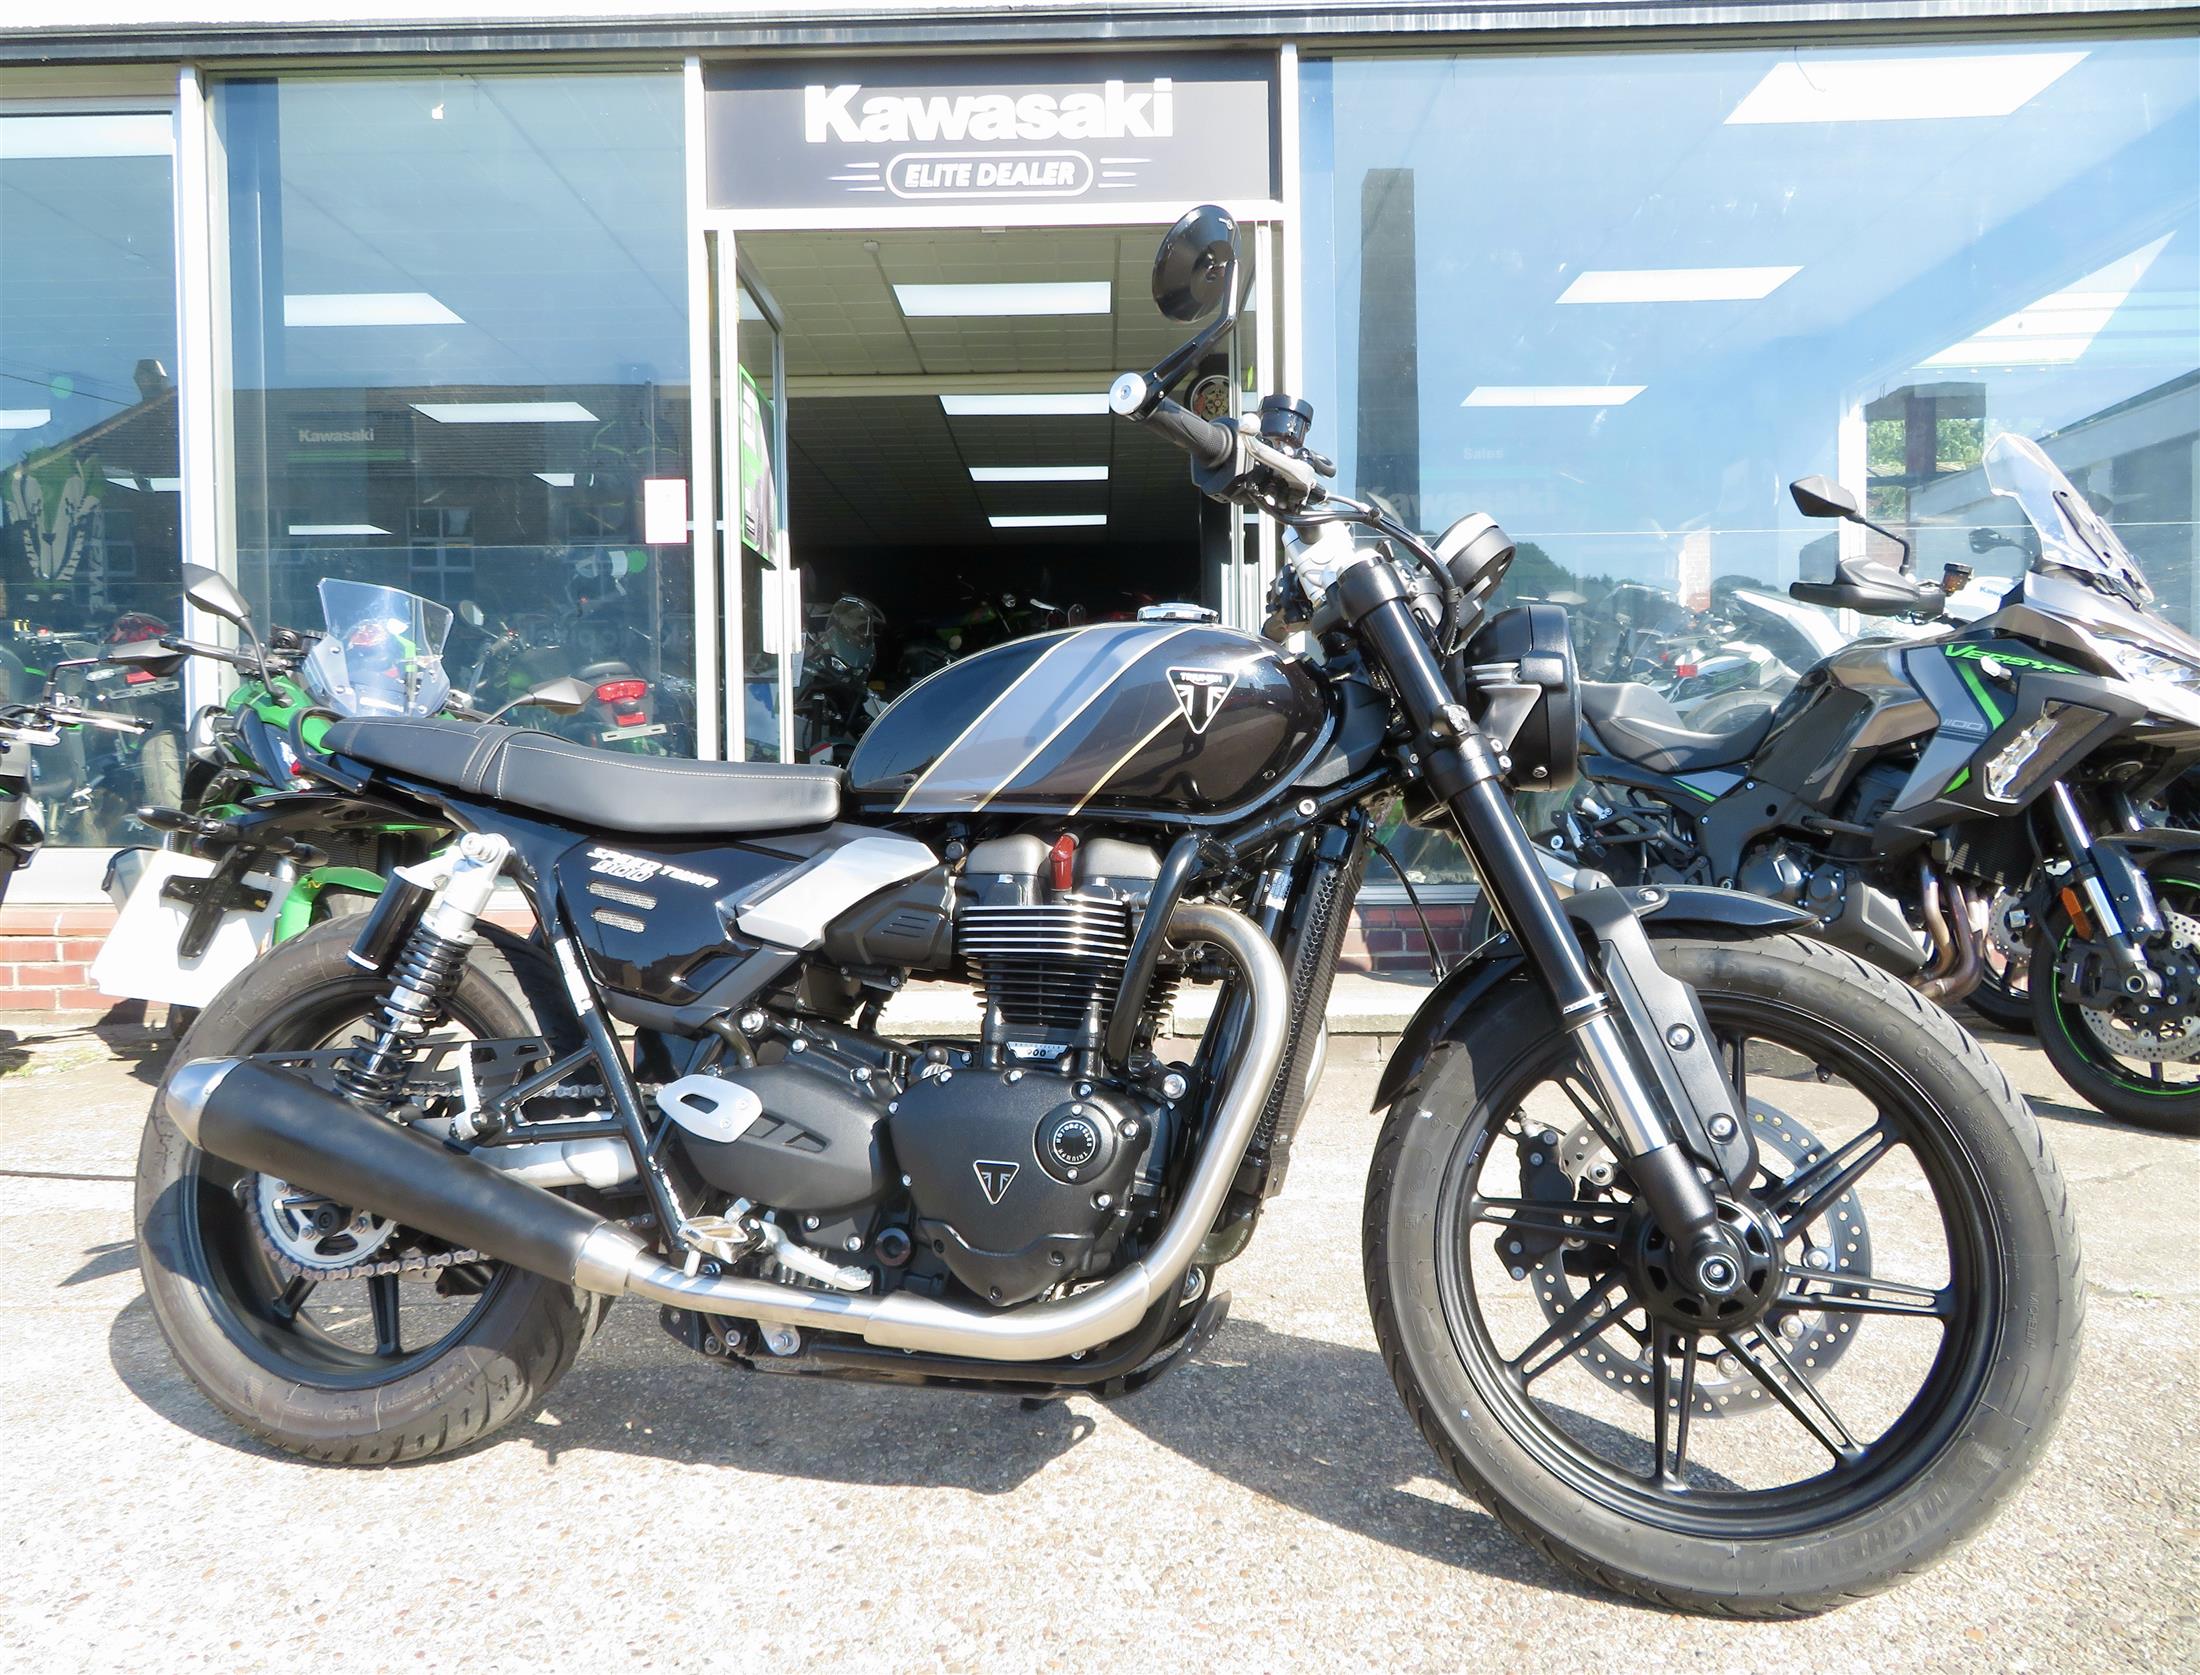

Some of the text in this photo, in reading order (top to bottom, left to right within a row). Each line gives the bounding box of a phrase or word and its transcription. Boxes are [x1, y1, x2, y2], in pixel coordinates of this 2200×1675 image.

[804, 77, 1173, 143] Kawasaki
[904, 160, 1076, 188] ELITE DEALER
[299, 428, 375, 442] Kawasaki
[586, 848, 719, 889] SPEED TWIN
[590, 860, 655, 883] 900
[1056, 1123, 1092, 1147] MOTORCYCLES
[1058, 1148, 1088, 1162] TRIUMPH
